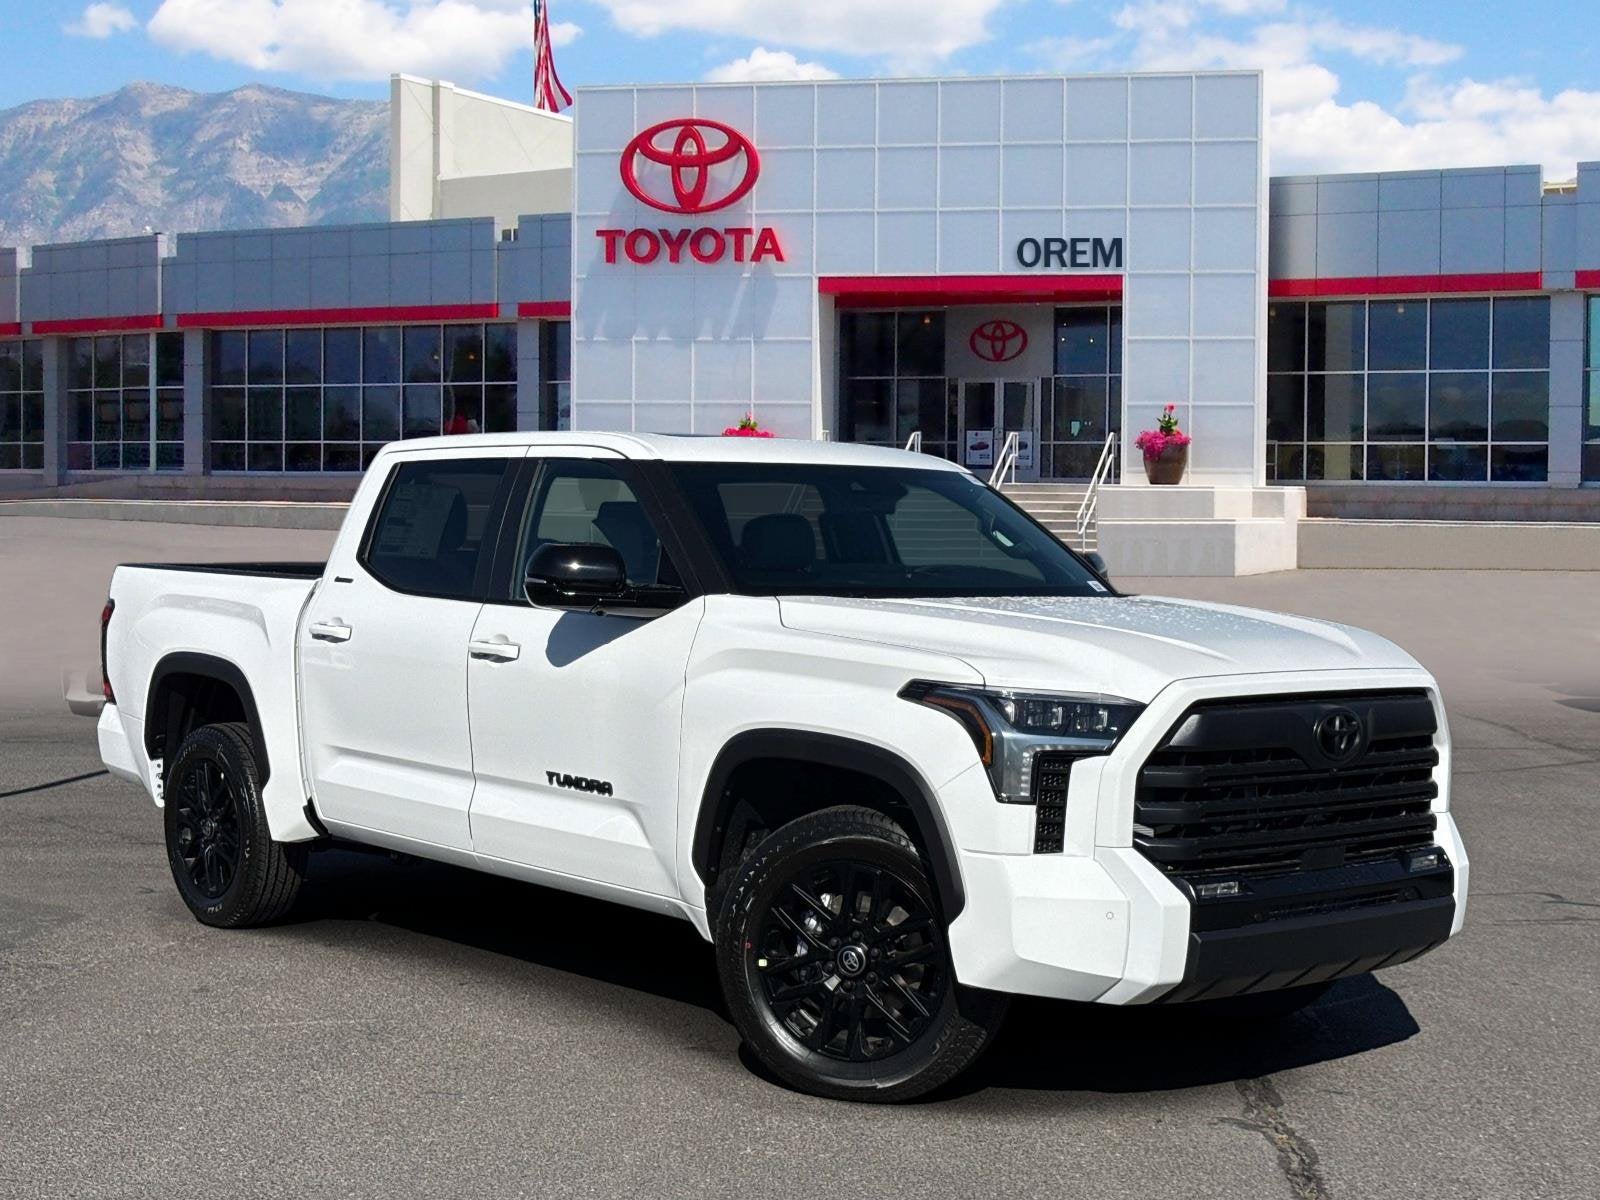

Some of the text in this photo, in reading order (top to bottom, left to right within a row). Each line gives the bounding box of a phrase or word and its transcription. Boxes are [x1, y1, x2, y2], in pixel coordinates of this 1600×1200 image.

[596, 227, 785, 265] TOYOTA
[1016, 237, 1123, 268] OREM
[545, 770, 614, 797] TUNDRA
